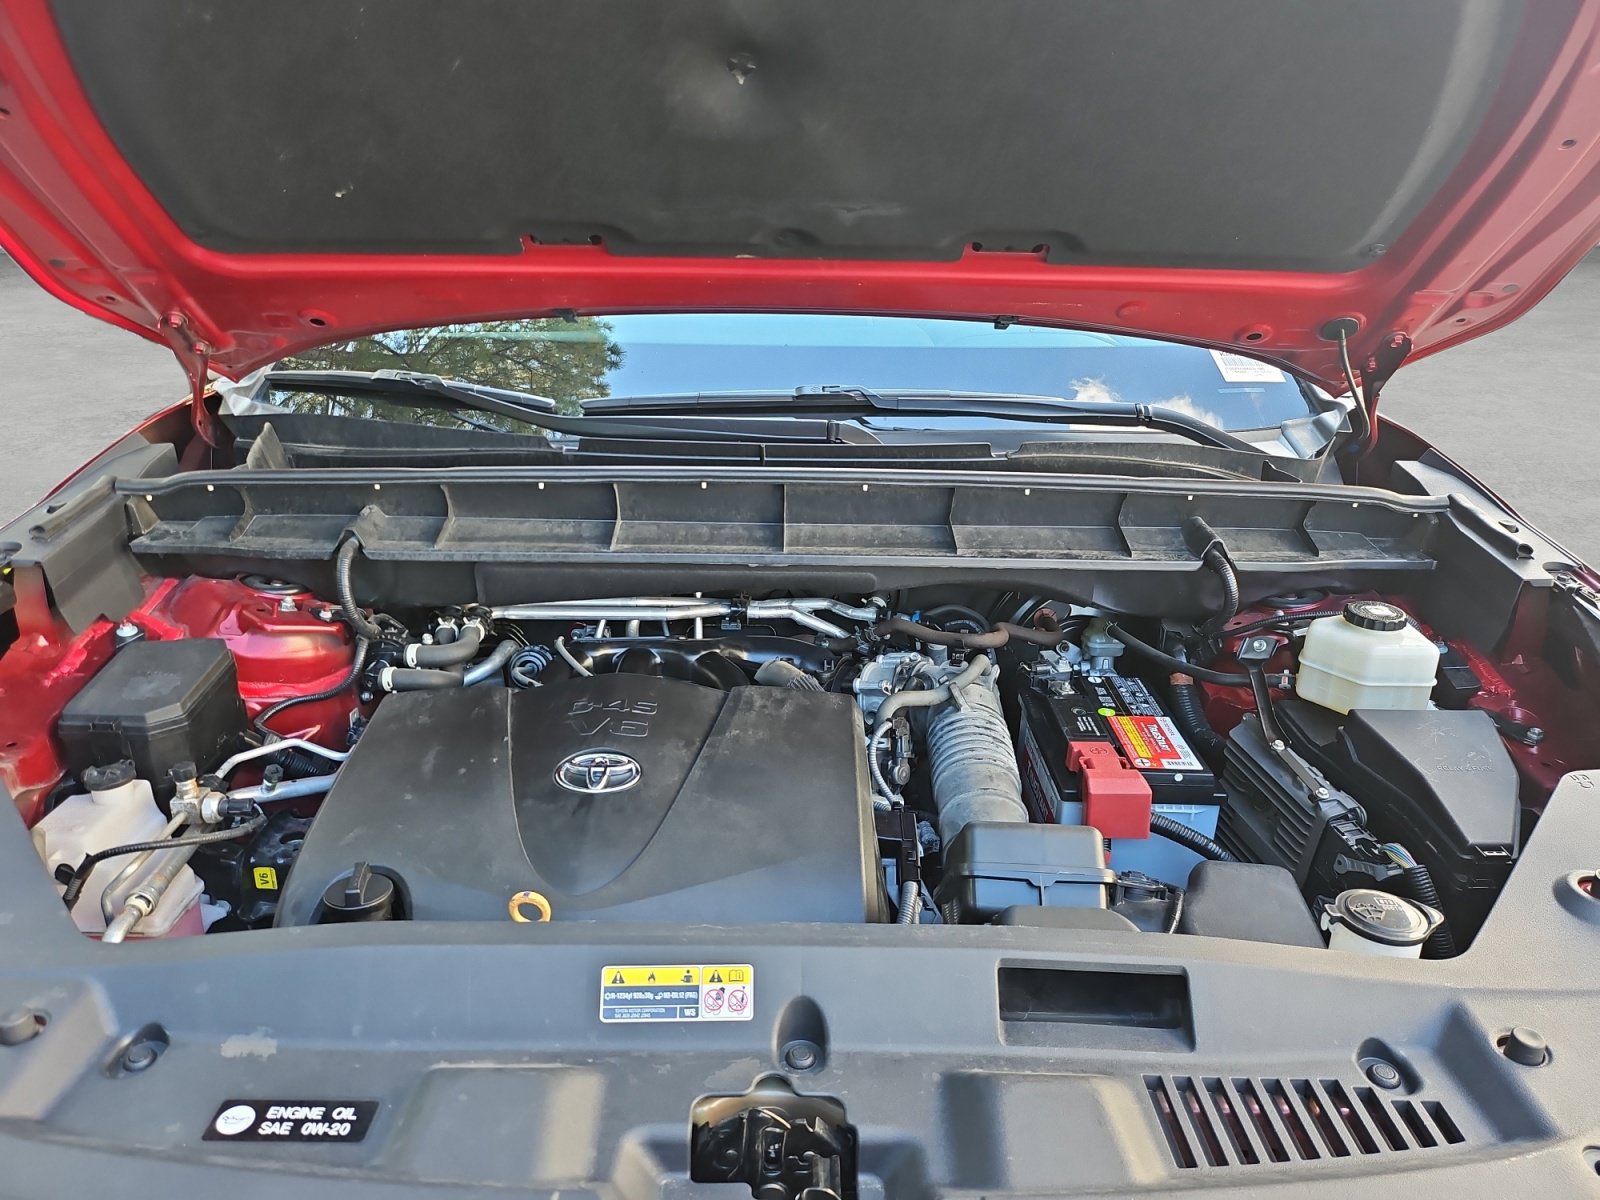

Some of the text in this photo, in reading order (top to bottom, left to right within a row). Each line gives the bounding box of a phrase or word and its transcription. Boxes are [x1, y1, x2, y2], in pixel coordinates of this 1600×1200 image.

[565, 717, 649, 737] V6
[259, 873, 269, 885] V6
[684, 1008, 696, 1017] WS
[265, 1106, 357, 1120] ENGINE OIL
[257, 1121, 351, 1136] SAE 0W-20
